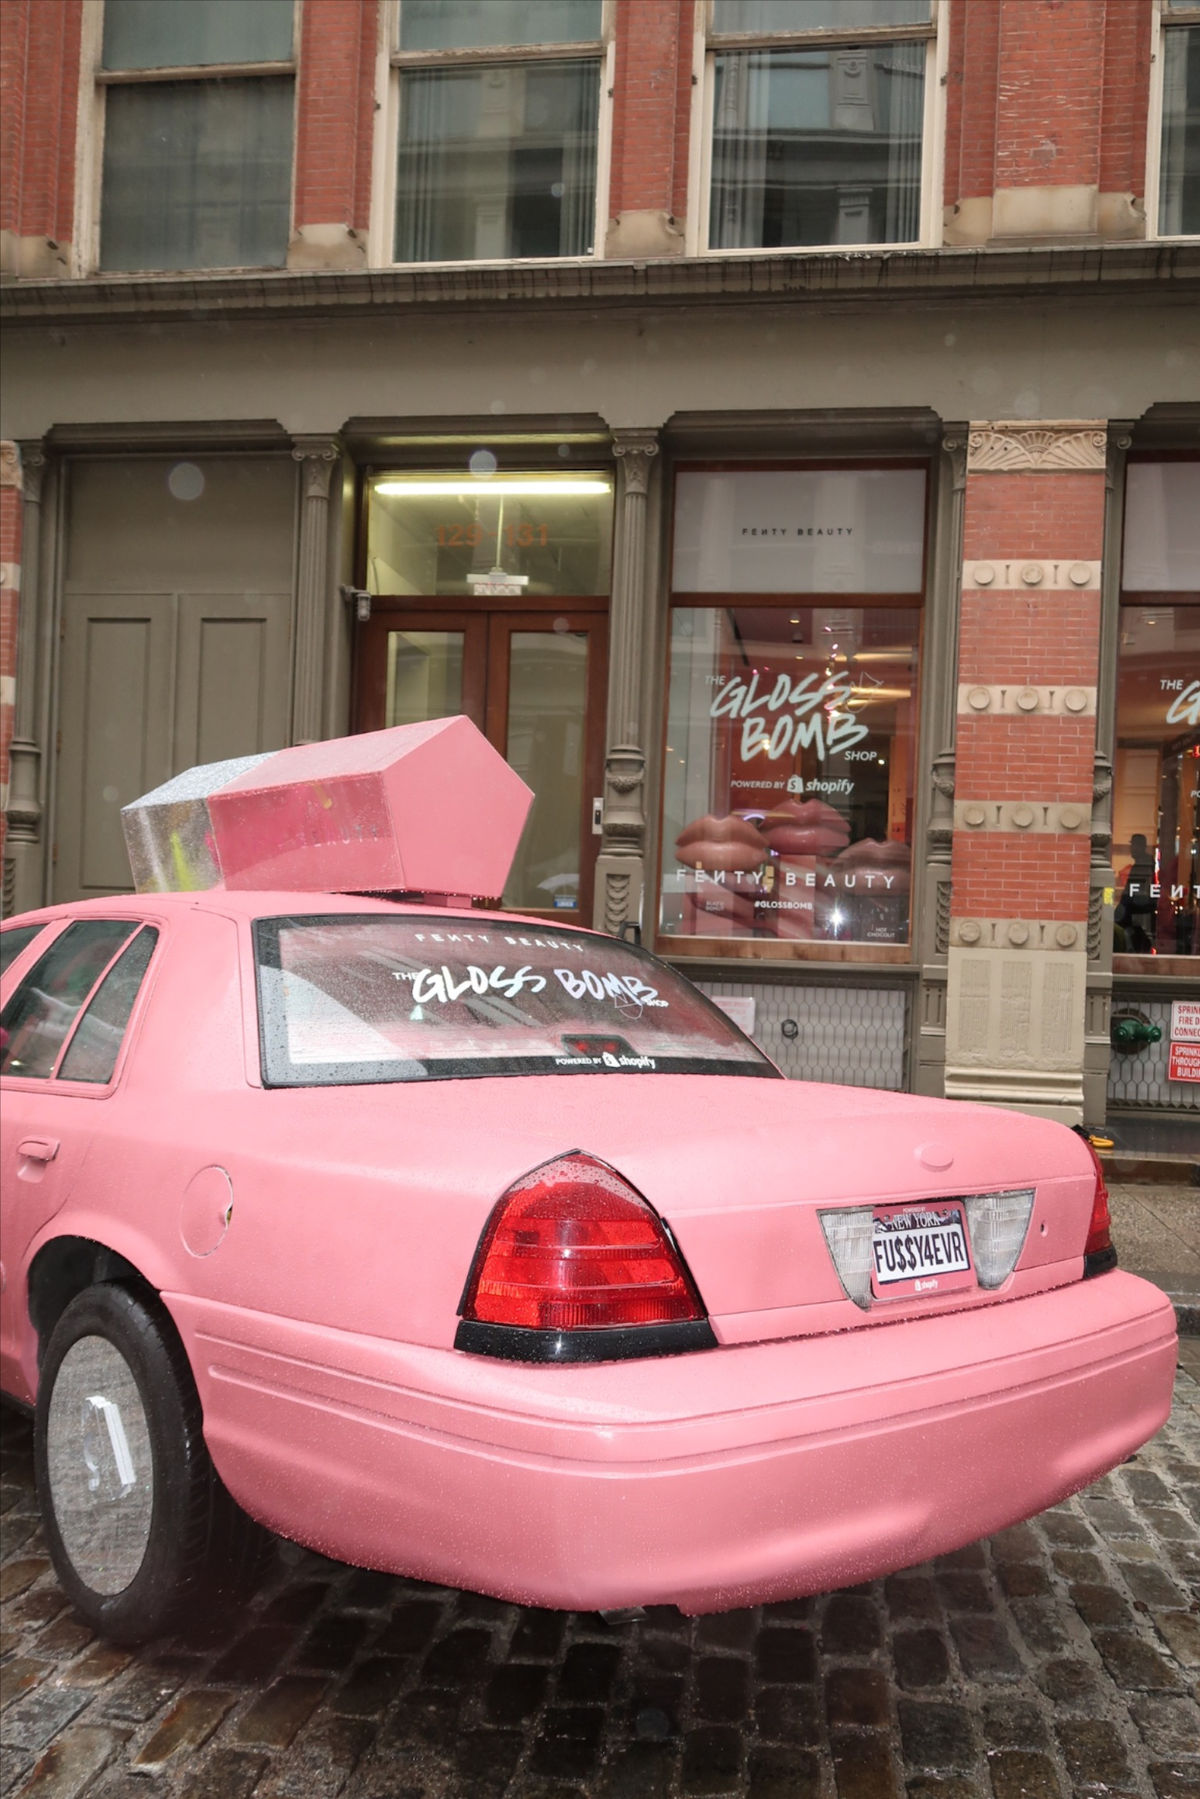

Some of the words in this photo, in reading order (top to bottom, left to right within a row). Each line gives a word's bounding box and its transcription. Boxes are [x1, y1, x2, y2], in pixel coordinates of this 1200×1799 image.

[797, 528, 853, 536] BEAUTY
[704, 675, 726, 686] THE
[1160, 679, 1184, 690] THE
[710, 670, 849, 719] GLOSS
[740, 712, 869, 761] BOMB
[844, 751, 877, 761] SHOP
[730, 780, 773, 789] POWERED
[773, 781, 785, 789] BY
[805, 779, 855, 794] shopify
[786, 872, 896, 889] BEAUTY
[754, 900, 813, 910] #GLOSSBOMB
[503, 936, 584, 951] BEAUTY
[391, 971, 417, 981] THE
[412, 965, 547, 1003] GLOSS
[553, 969, 659, 1006] BOMB
[1177, 1005, 1200, 1014] SPRIN
[1178, 1016, 1193, 1025] FIRE
[555, 1057, 592, 1065] POWERED
[618, 1055, 656, 1069] shopify
[892, 1213, 912, 1230] NEW
[912, 1211, 940, 1228] YORK
[873, 1231, 964, 1273] FU$$Y4EVR
